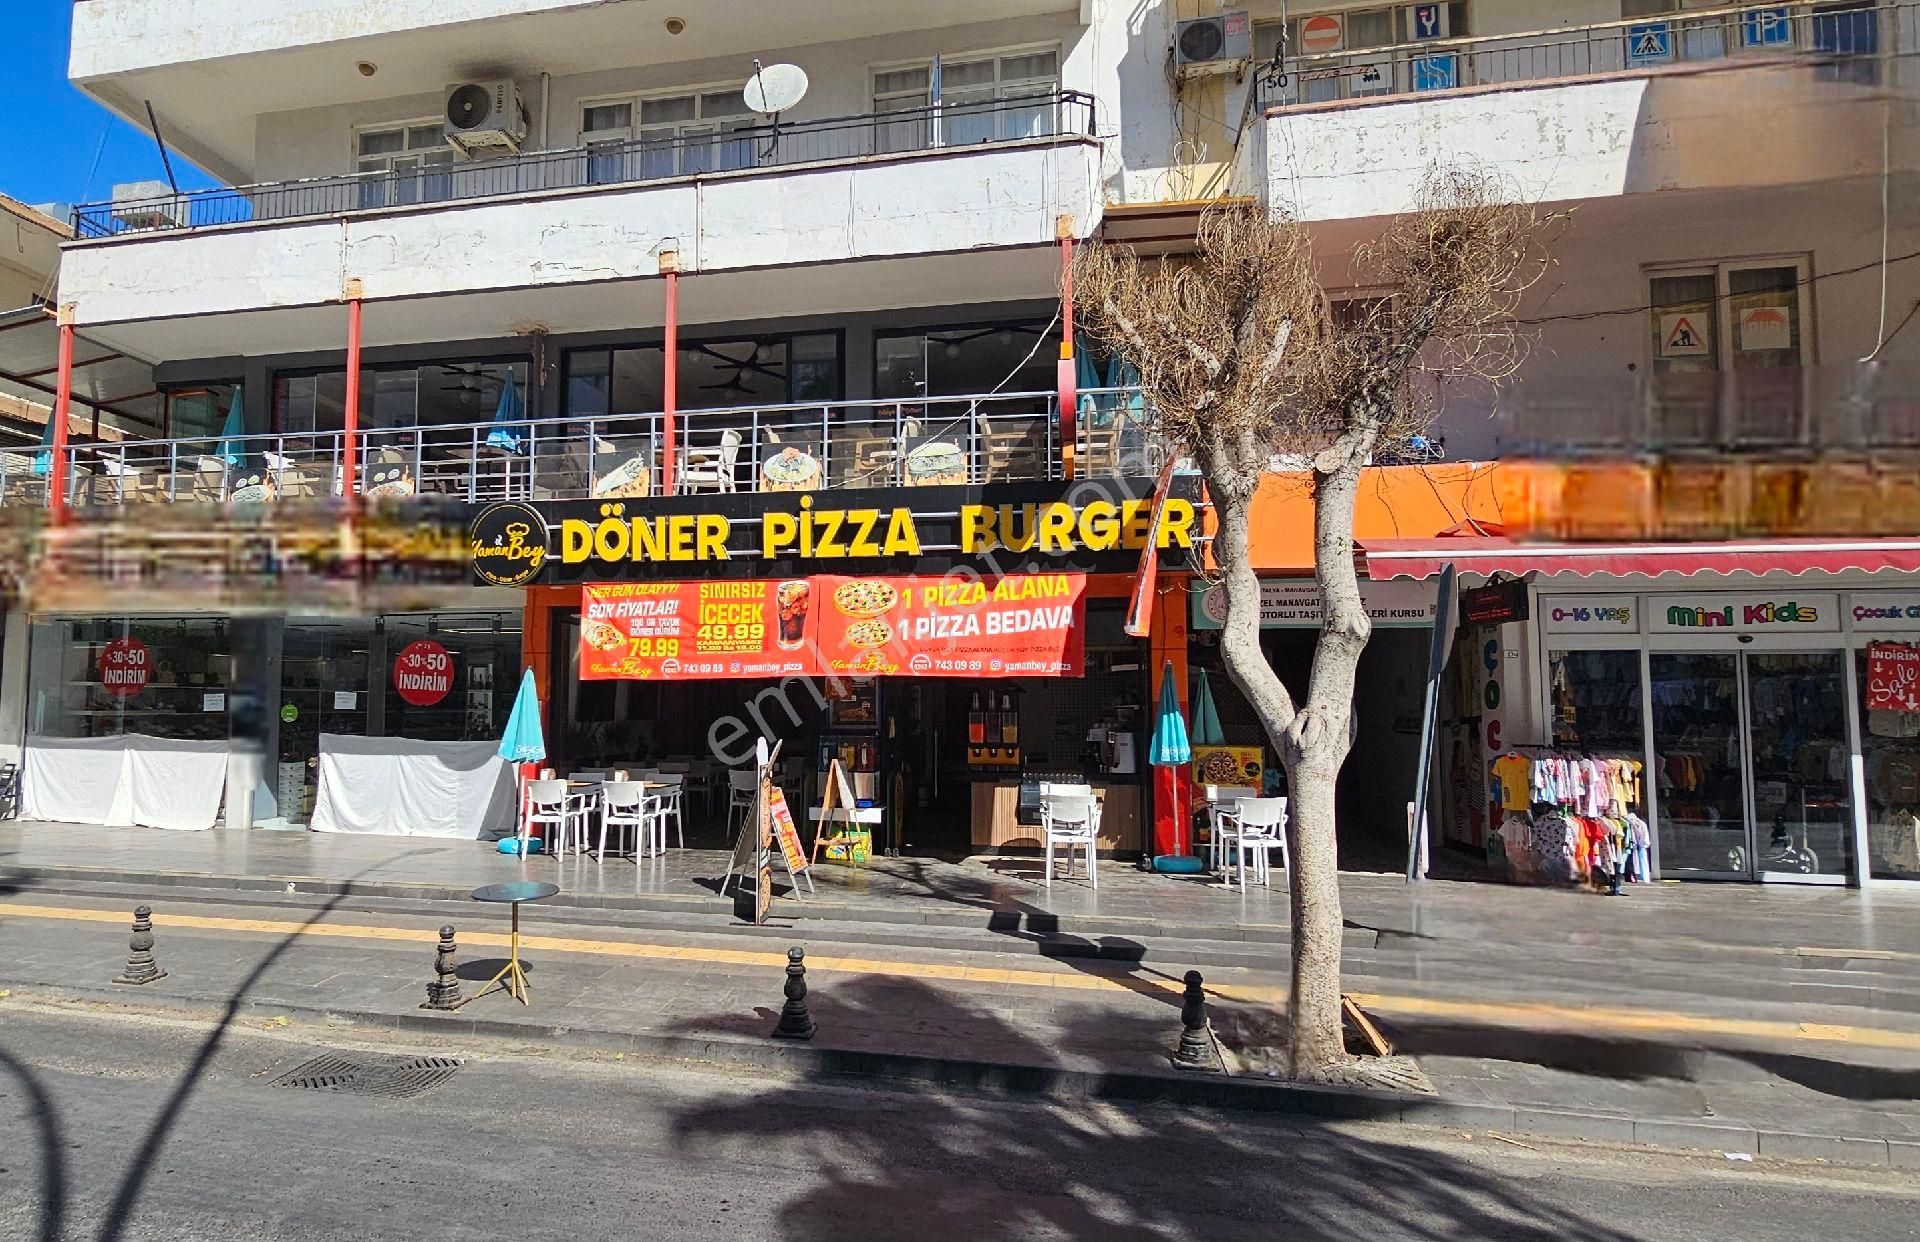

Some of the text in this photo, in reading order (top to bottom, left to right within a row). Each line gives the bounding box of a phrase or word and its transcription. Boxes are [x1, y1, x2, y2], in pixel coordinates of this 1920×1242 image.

[562, 494, 1196, 564] DÖNER PİZZA BURGER
[700, 582, 766, 598] SINIRSIZ
[901, 574, 1070, 609] 1 PİZZA ALANA
[1259, 598, 1321, 607] ZEL MANAVGAT
[1259, 610, 1296, 619] OTORLU
[1390, 609, 1425, 618] KURSU
[1551, 606, 1631, 624] 0-16 YAŞ
[1666, 602, 1818, 627] mini Kids
[1852, 605, 1920, 622] Çocuk Gi
[696, 624, 765, 641] 49.99
[898, 605, 1075, 642] 1 PİZZA BEDAVA
[628, 637, 679, 657] 79.99
[1870, 648, 1920, 661] İNDİRİM
[935, 660, 953, 671] 743
[954, 660, 967, 671] 09
[104, 666, 146, 684] İNDİRİM
[399, 671, 447, 692] İNDİRİM
[1871, 663, 1919, 702] Sale
